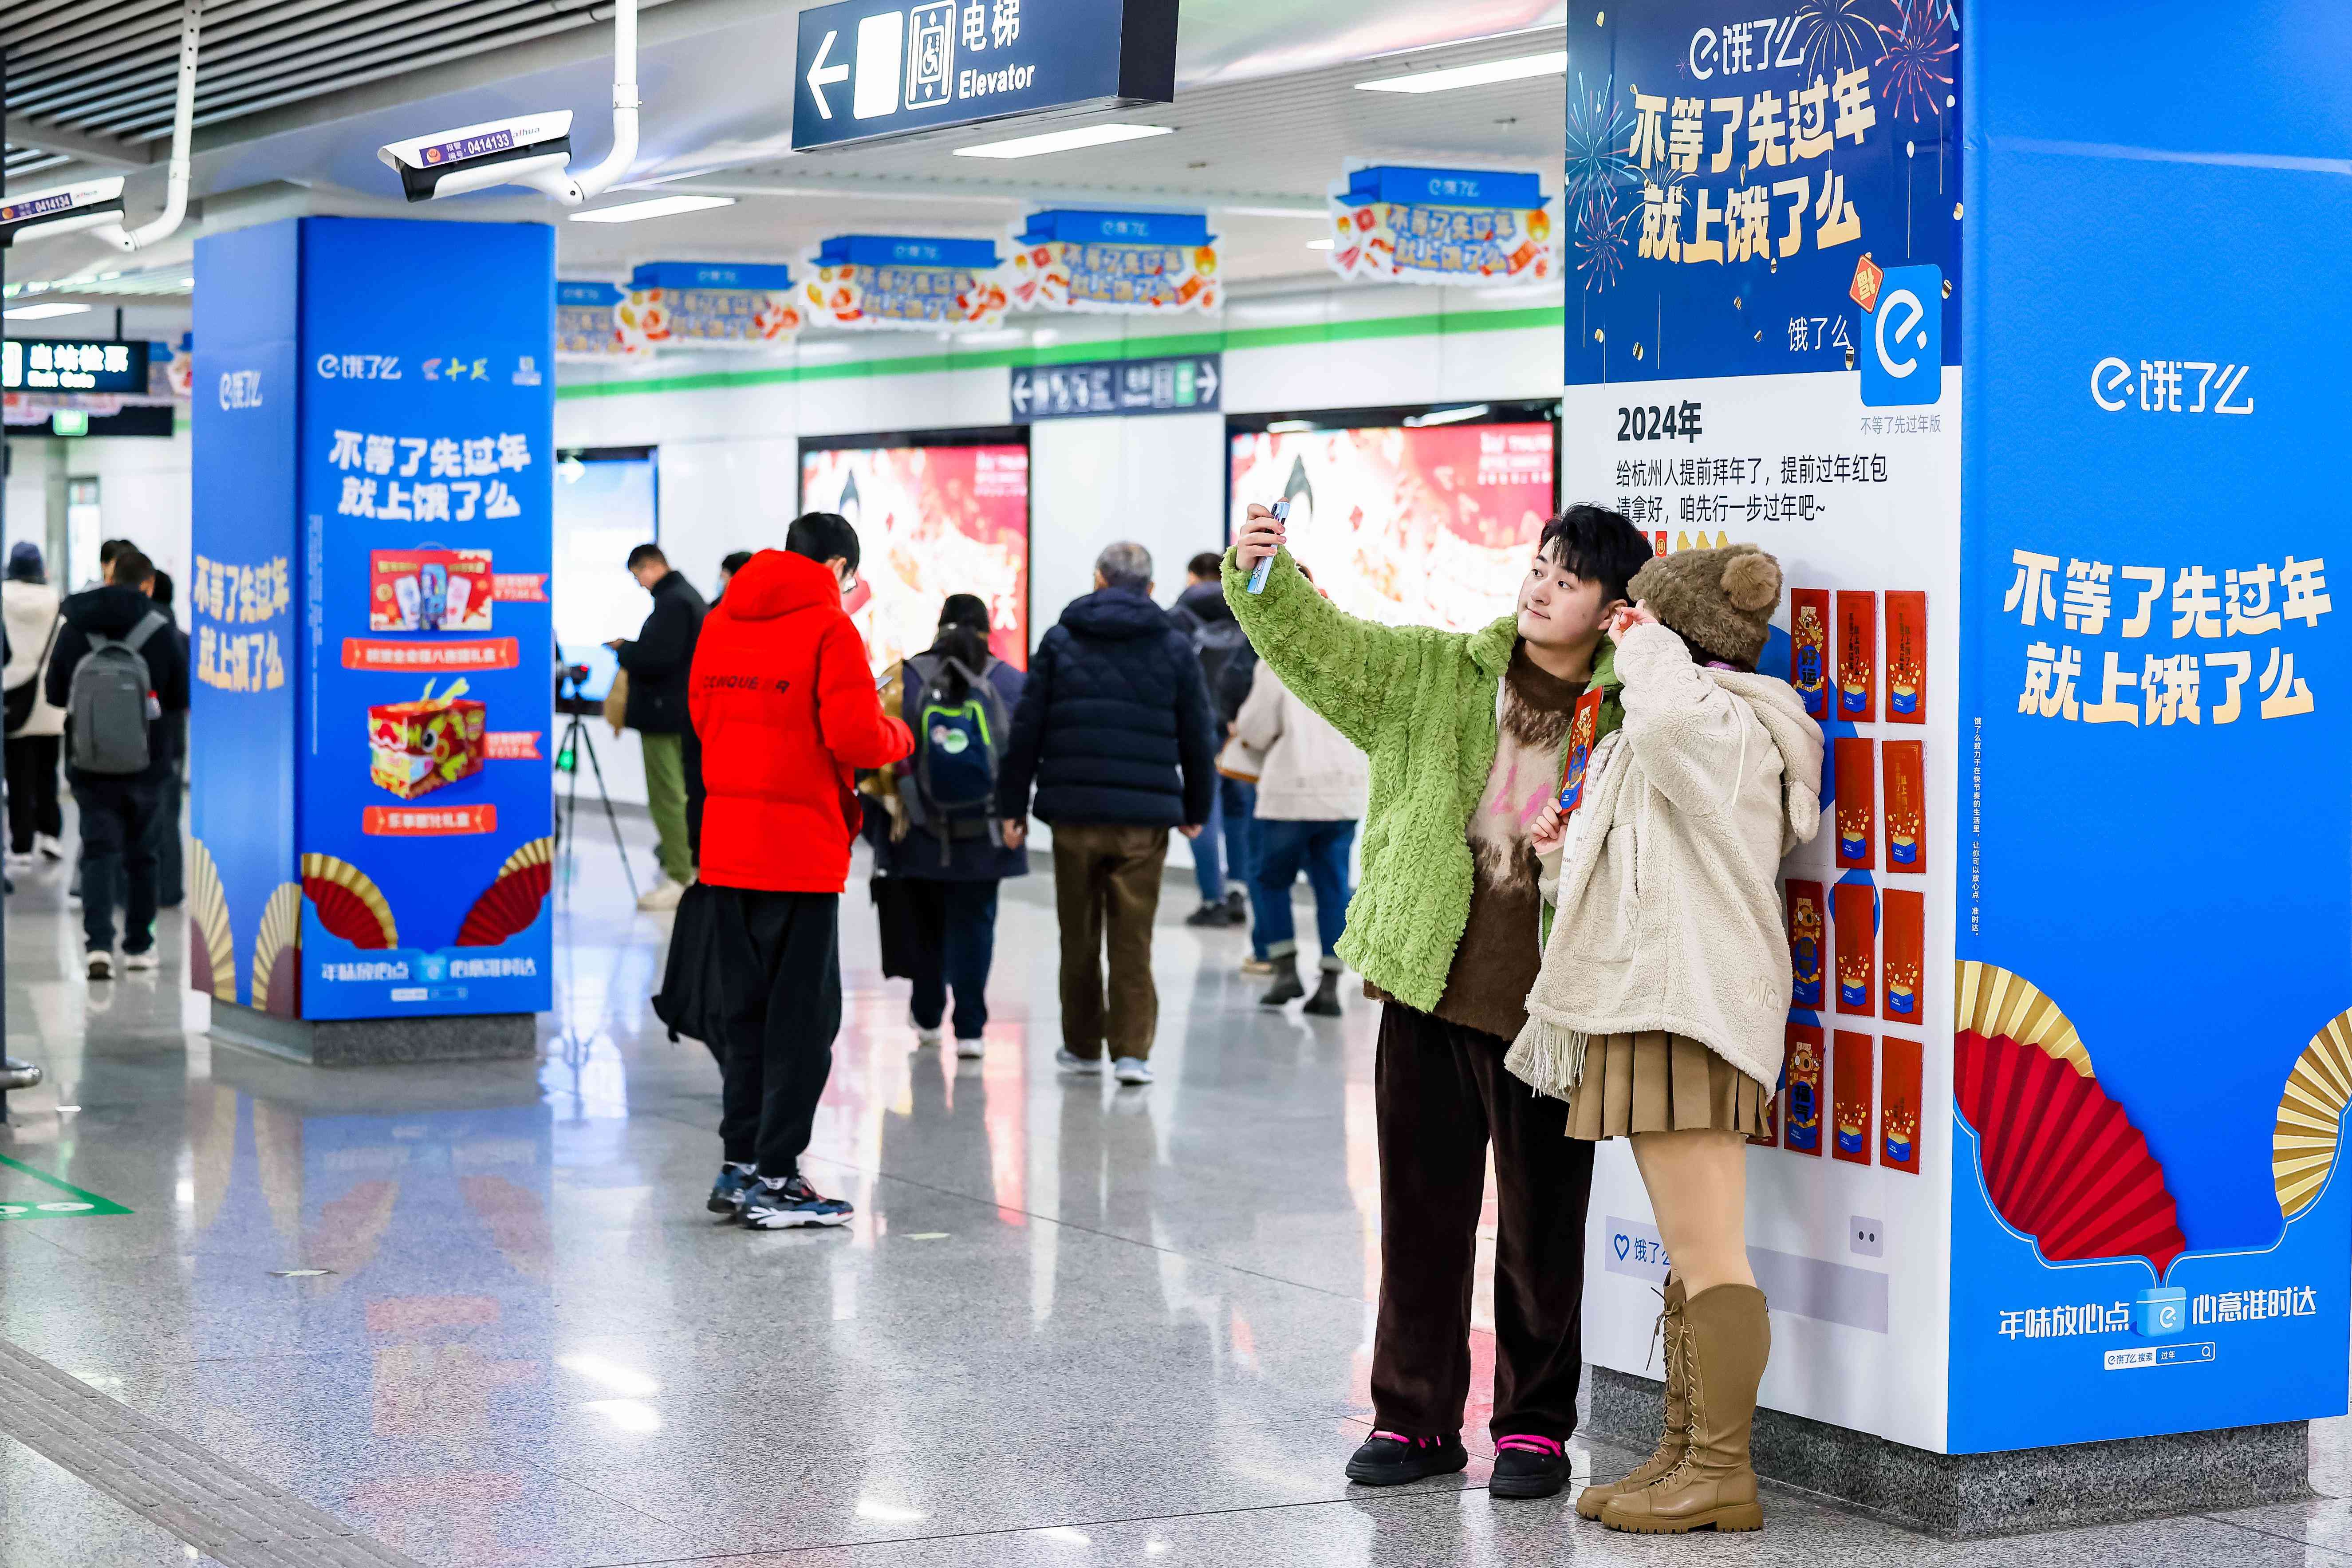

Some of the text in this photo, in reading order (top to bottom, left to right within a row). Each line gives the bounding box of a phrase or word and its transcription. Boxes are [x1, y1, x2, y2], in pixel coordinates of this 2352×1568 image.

[962, 0, 1020, 52] 电梯
[958, 63, 1036, 100] Elevator
[1629, 67, 1876, 174] 不等了先过年
[468, 134, 509, 154] 0414133
[1638, 169, 1861, 265] 就上饿了么
[1788, 315, 1850, 352] 饿了么
[1617, 400, 1702, 443] 2024年
[1861, 414, 1941, 435] 不等了先过年版
[329, 429, 531, 478] 不等了先过年
[1616, 453, 1888, 487] 给杭州人提前拜年了，提前过年红包
[338, 476, 521, 522] 就上饿了么
[194, 555, 290, 623] 不等了先过年
[2002, 548, 2332, 640] 不等了先过年
[197, 627, 284, 693] 就上饿了么
[2017, 641, 2315, 728] 就上饿了么
[1998, 1301, 2130, 1341] 年味放心点
[2193, 1285, 2317, 1326] 心意准时达
[2161, 1351, 2175, 1360] 过年
